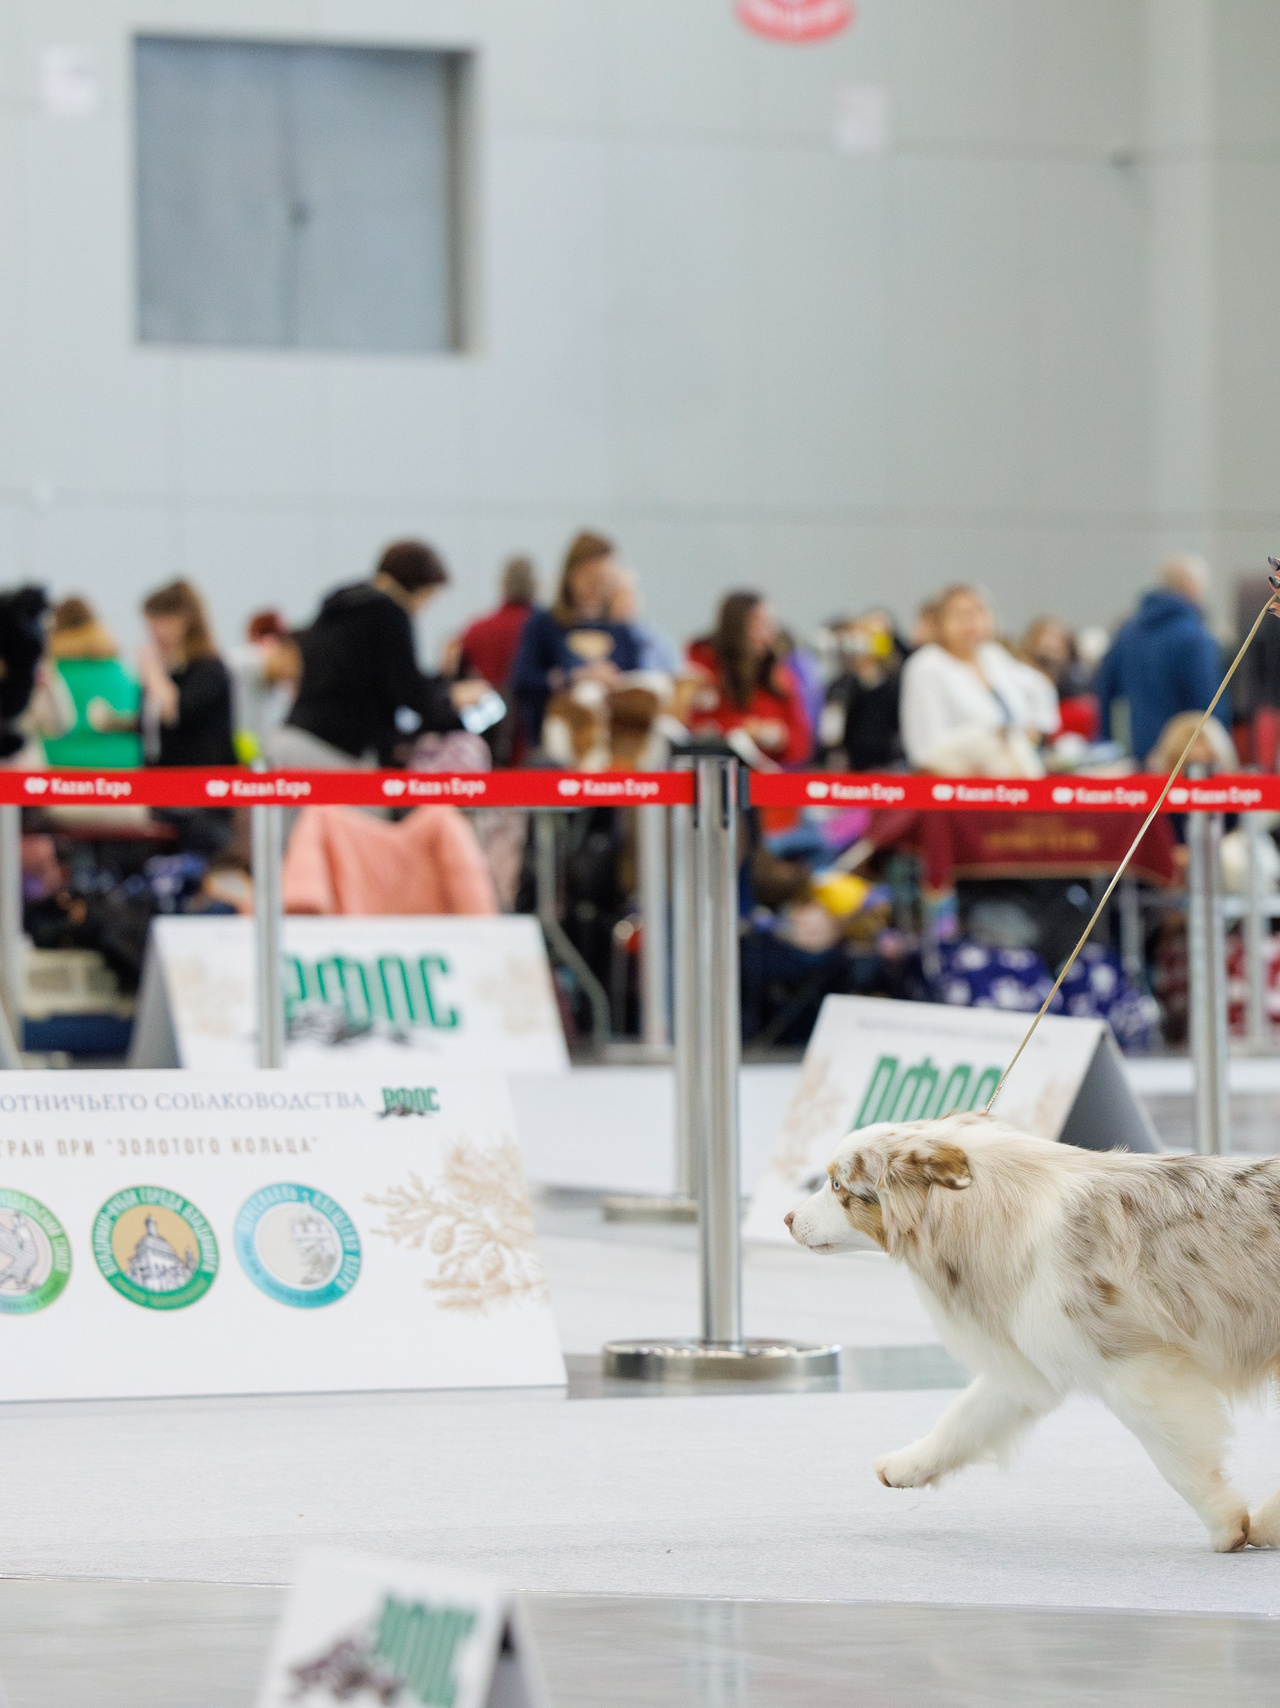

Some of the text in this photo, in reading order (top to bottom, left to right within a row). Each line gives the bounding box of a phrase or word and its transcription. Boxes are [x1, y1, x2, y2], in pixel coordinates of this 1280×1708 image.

[51, 778, 132, 799] Kazan Expo
[231, 779, 312, 798] Kazan Expo
[155, 1091, 366, 1111] СОБАКОВОДСТВА
[0, 1138, 46, 1157] РАН
[56, 1138, 96, 1157] ПРИ
